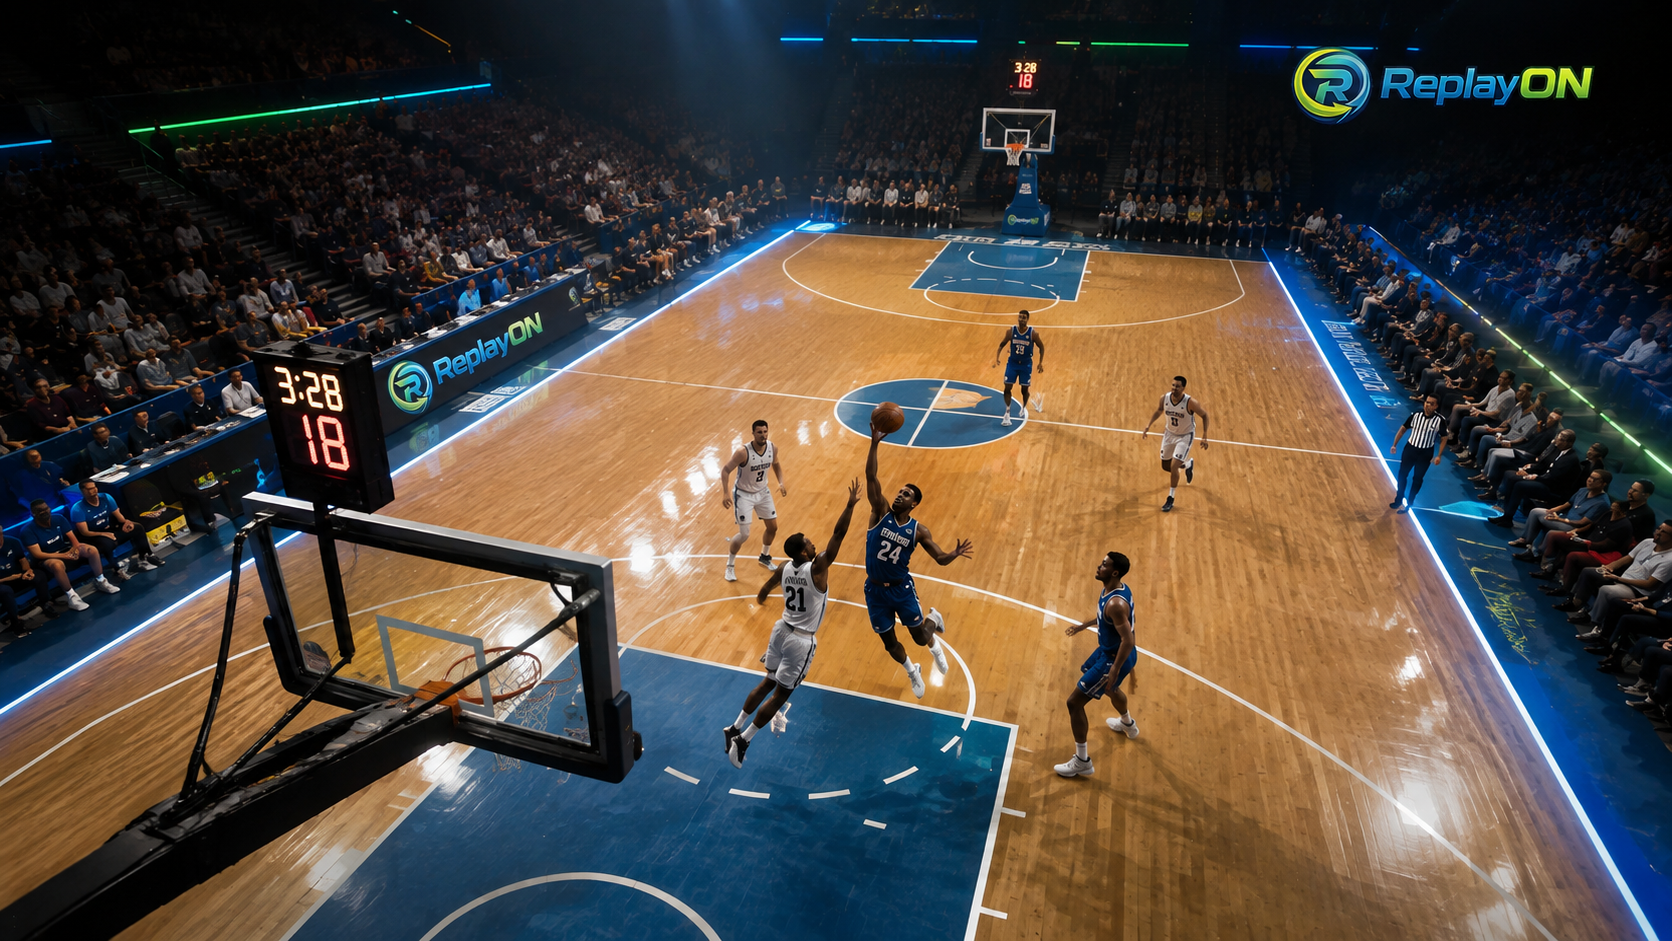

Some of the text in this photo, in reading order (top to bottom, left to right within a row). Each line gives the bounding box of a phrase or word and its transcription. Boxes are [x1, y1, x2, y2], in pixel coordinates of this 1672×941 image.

[1018, 73, 1033, 89] 18
[432, 311, 544, 385] ReplayON
[273, 366, 344, 412] 3:28
[301, 414, 350, 471] 18
[876, 540, 902, 565] 24
[785, 585, 807, 612] 21
